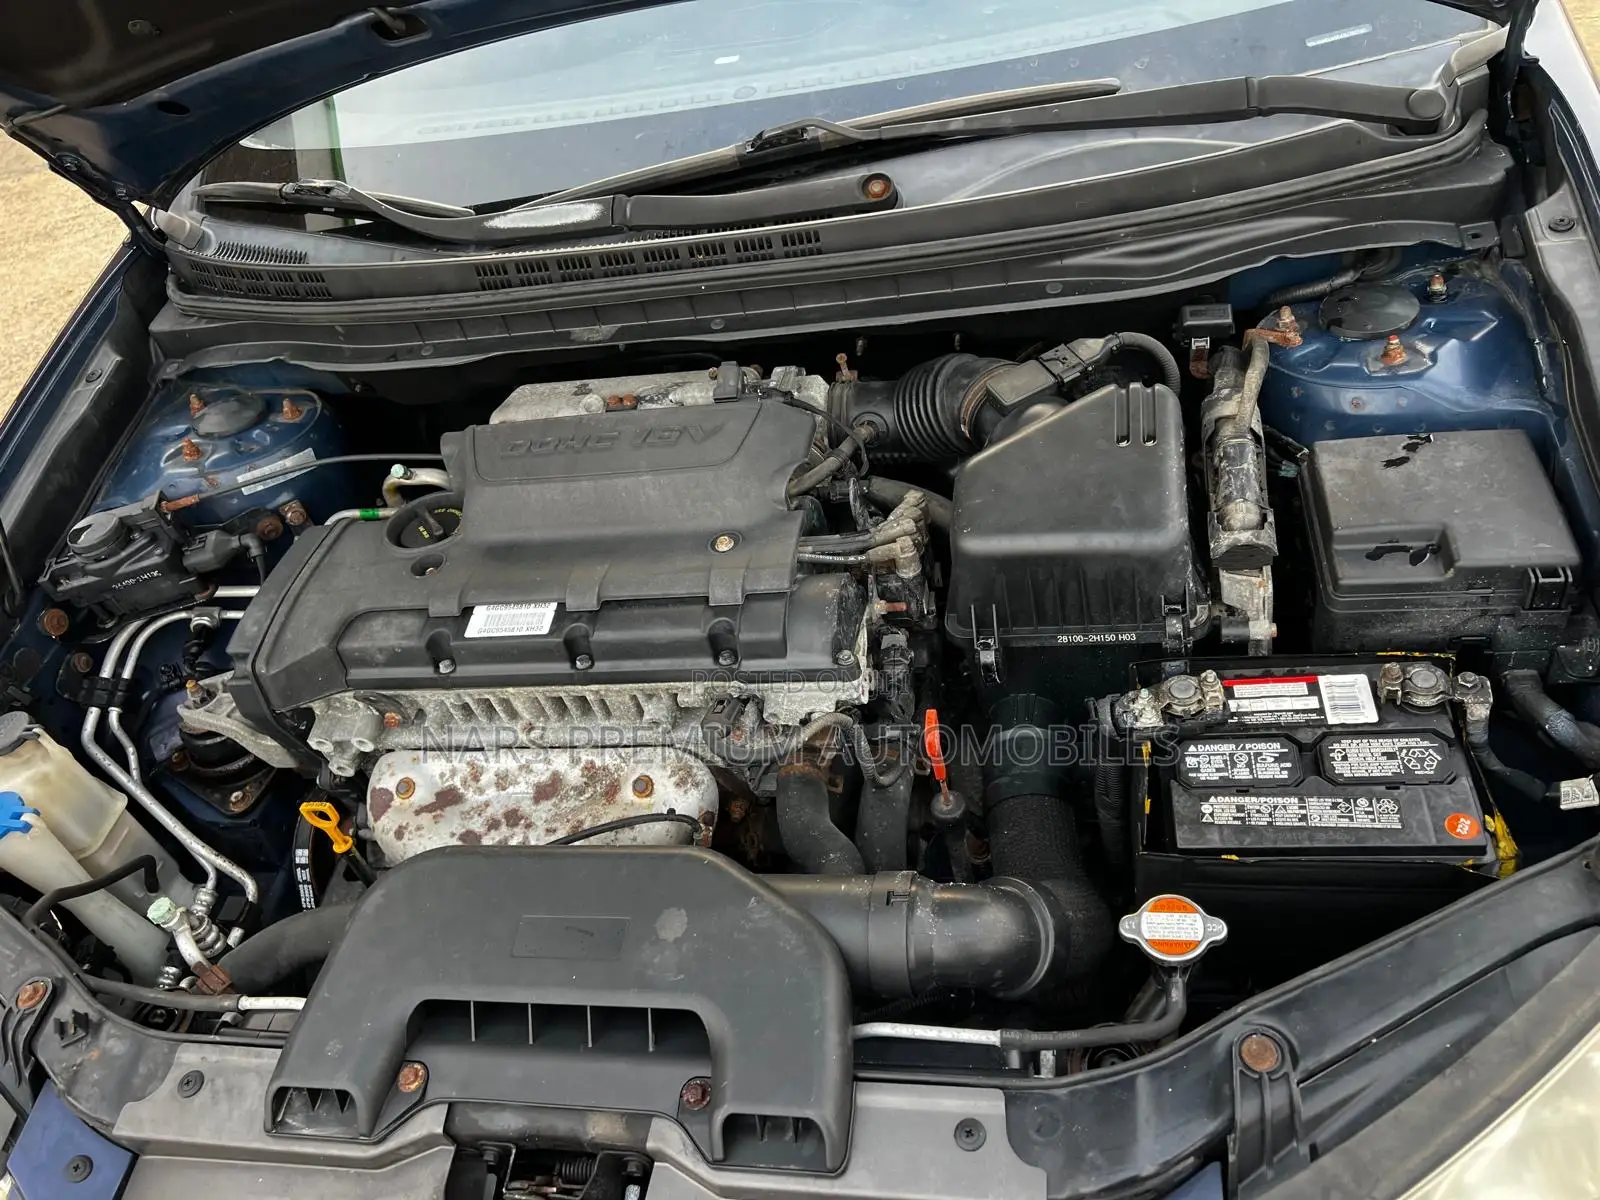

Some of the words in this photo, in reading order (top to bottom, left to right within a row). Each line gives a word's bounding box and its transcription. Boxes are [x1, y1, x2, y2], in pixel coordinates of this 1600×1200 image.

[501, 431, 621, 459] DOHC
[1057, 634, 1116, 643] 28100-2H150
[1118, 633, 1137, 641] H03
[1197, 743, 1236, 751] DANGER
[1245, 742, 1281, 750] POISON
[1216, 796, 1299, 804] DANGER/POISON
